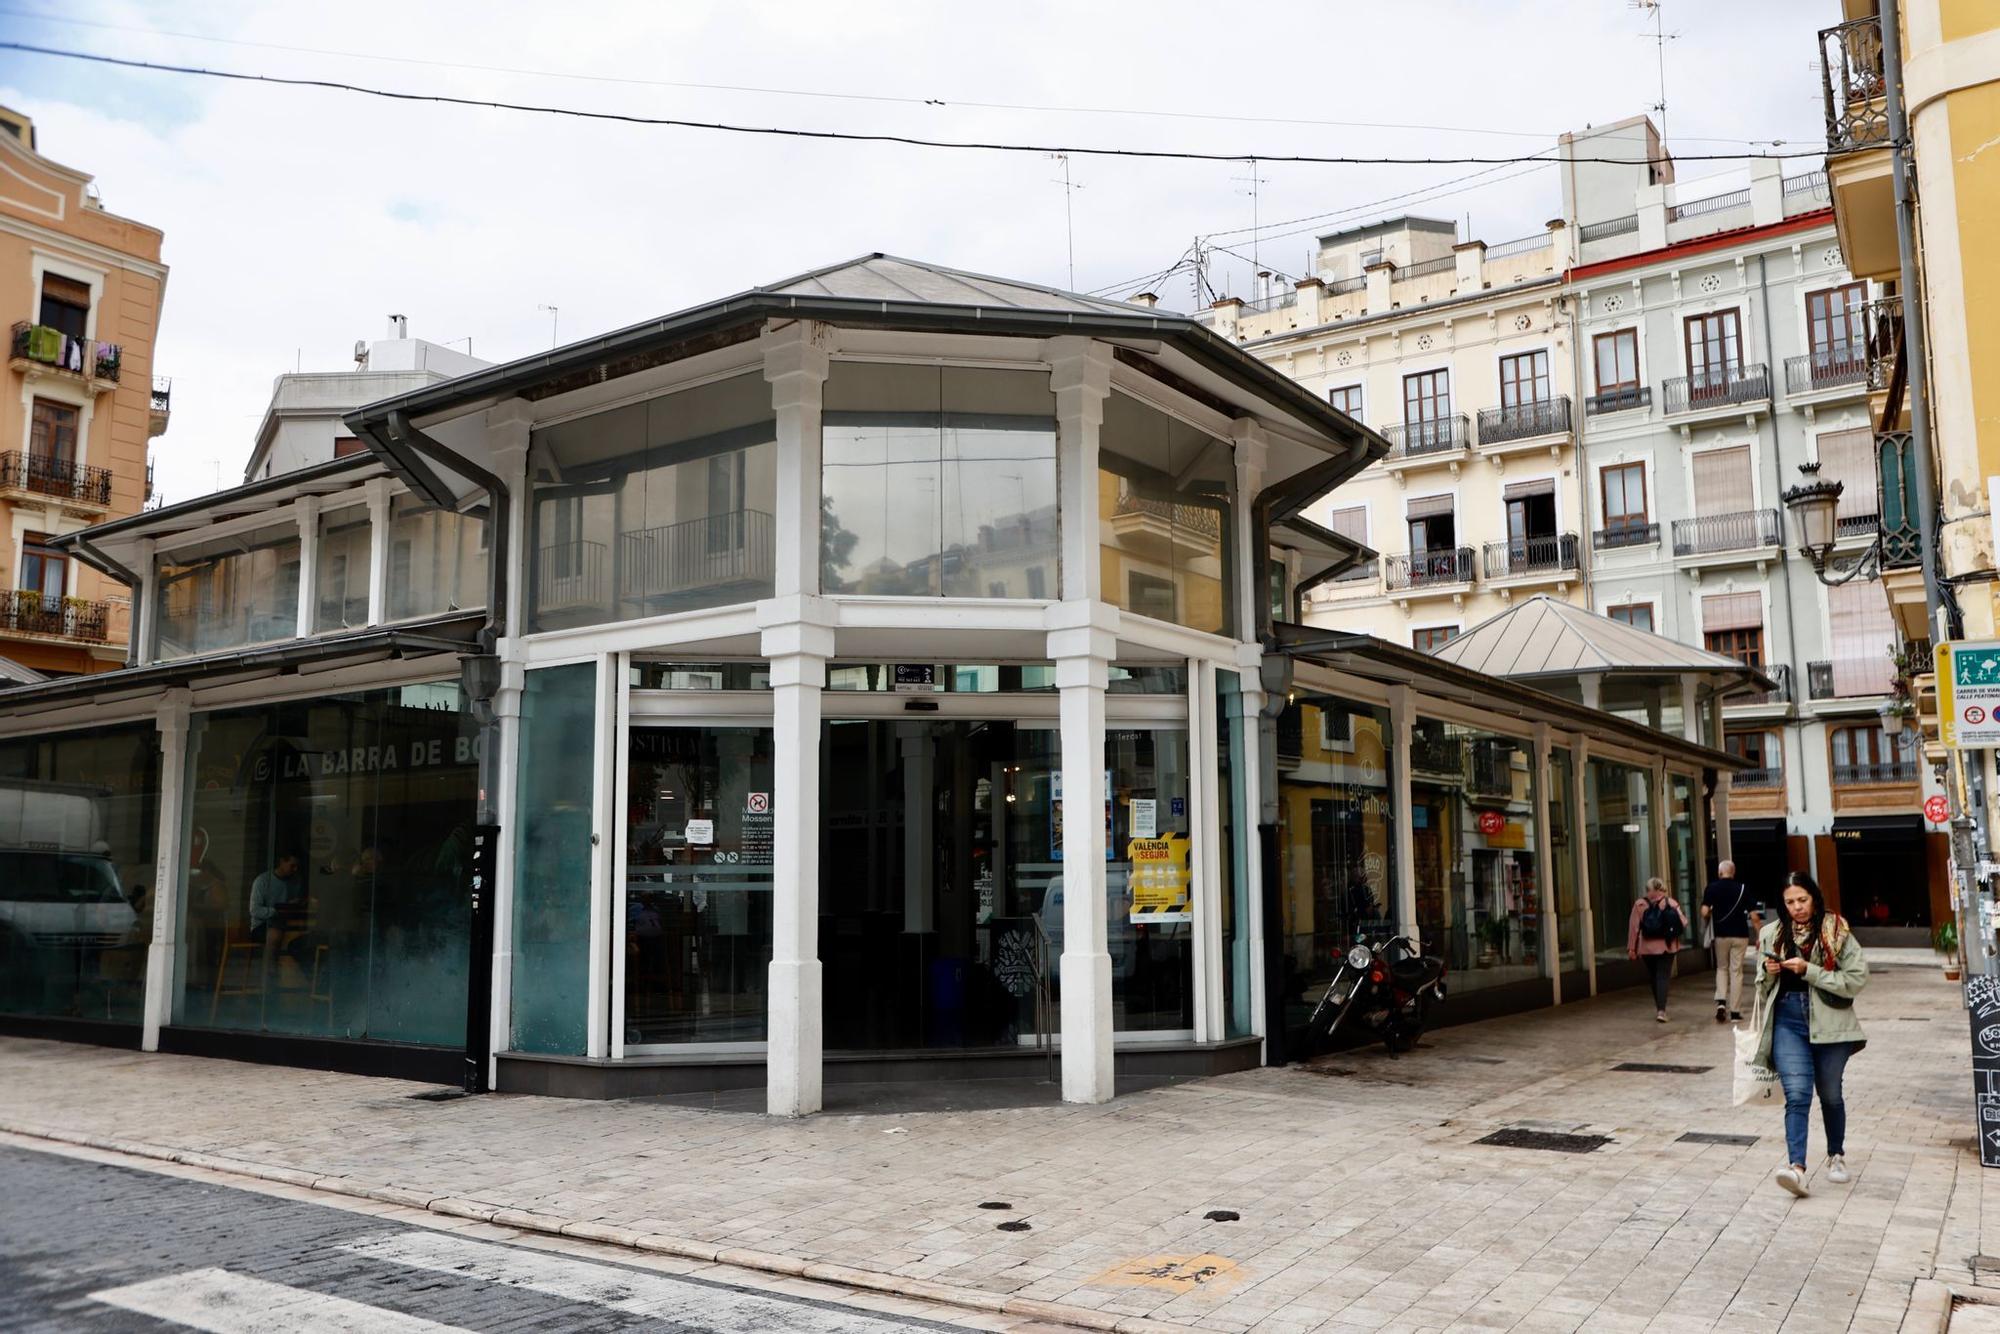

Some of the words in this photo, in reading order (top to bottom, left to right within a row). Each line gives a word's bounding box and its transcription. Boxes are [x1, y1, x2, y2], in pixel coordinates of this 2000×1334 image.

[284, 754, 309, 777] LA
[321, 746, 397, 774] BARRA
[411, 740, 441, 766] DE
[1349, 793, 1394, 819] CALAMAR
[741, 815, 772, 823] Mossen
[1140, 850, 1169, 859] SEGURA
[1763, 1088, 1771, 1099] J
